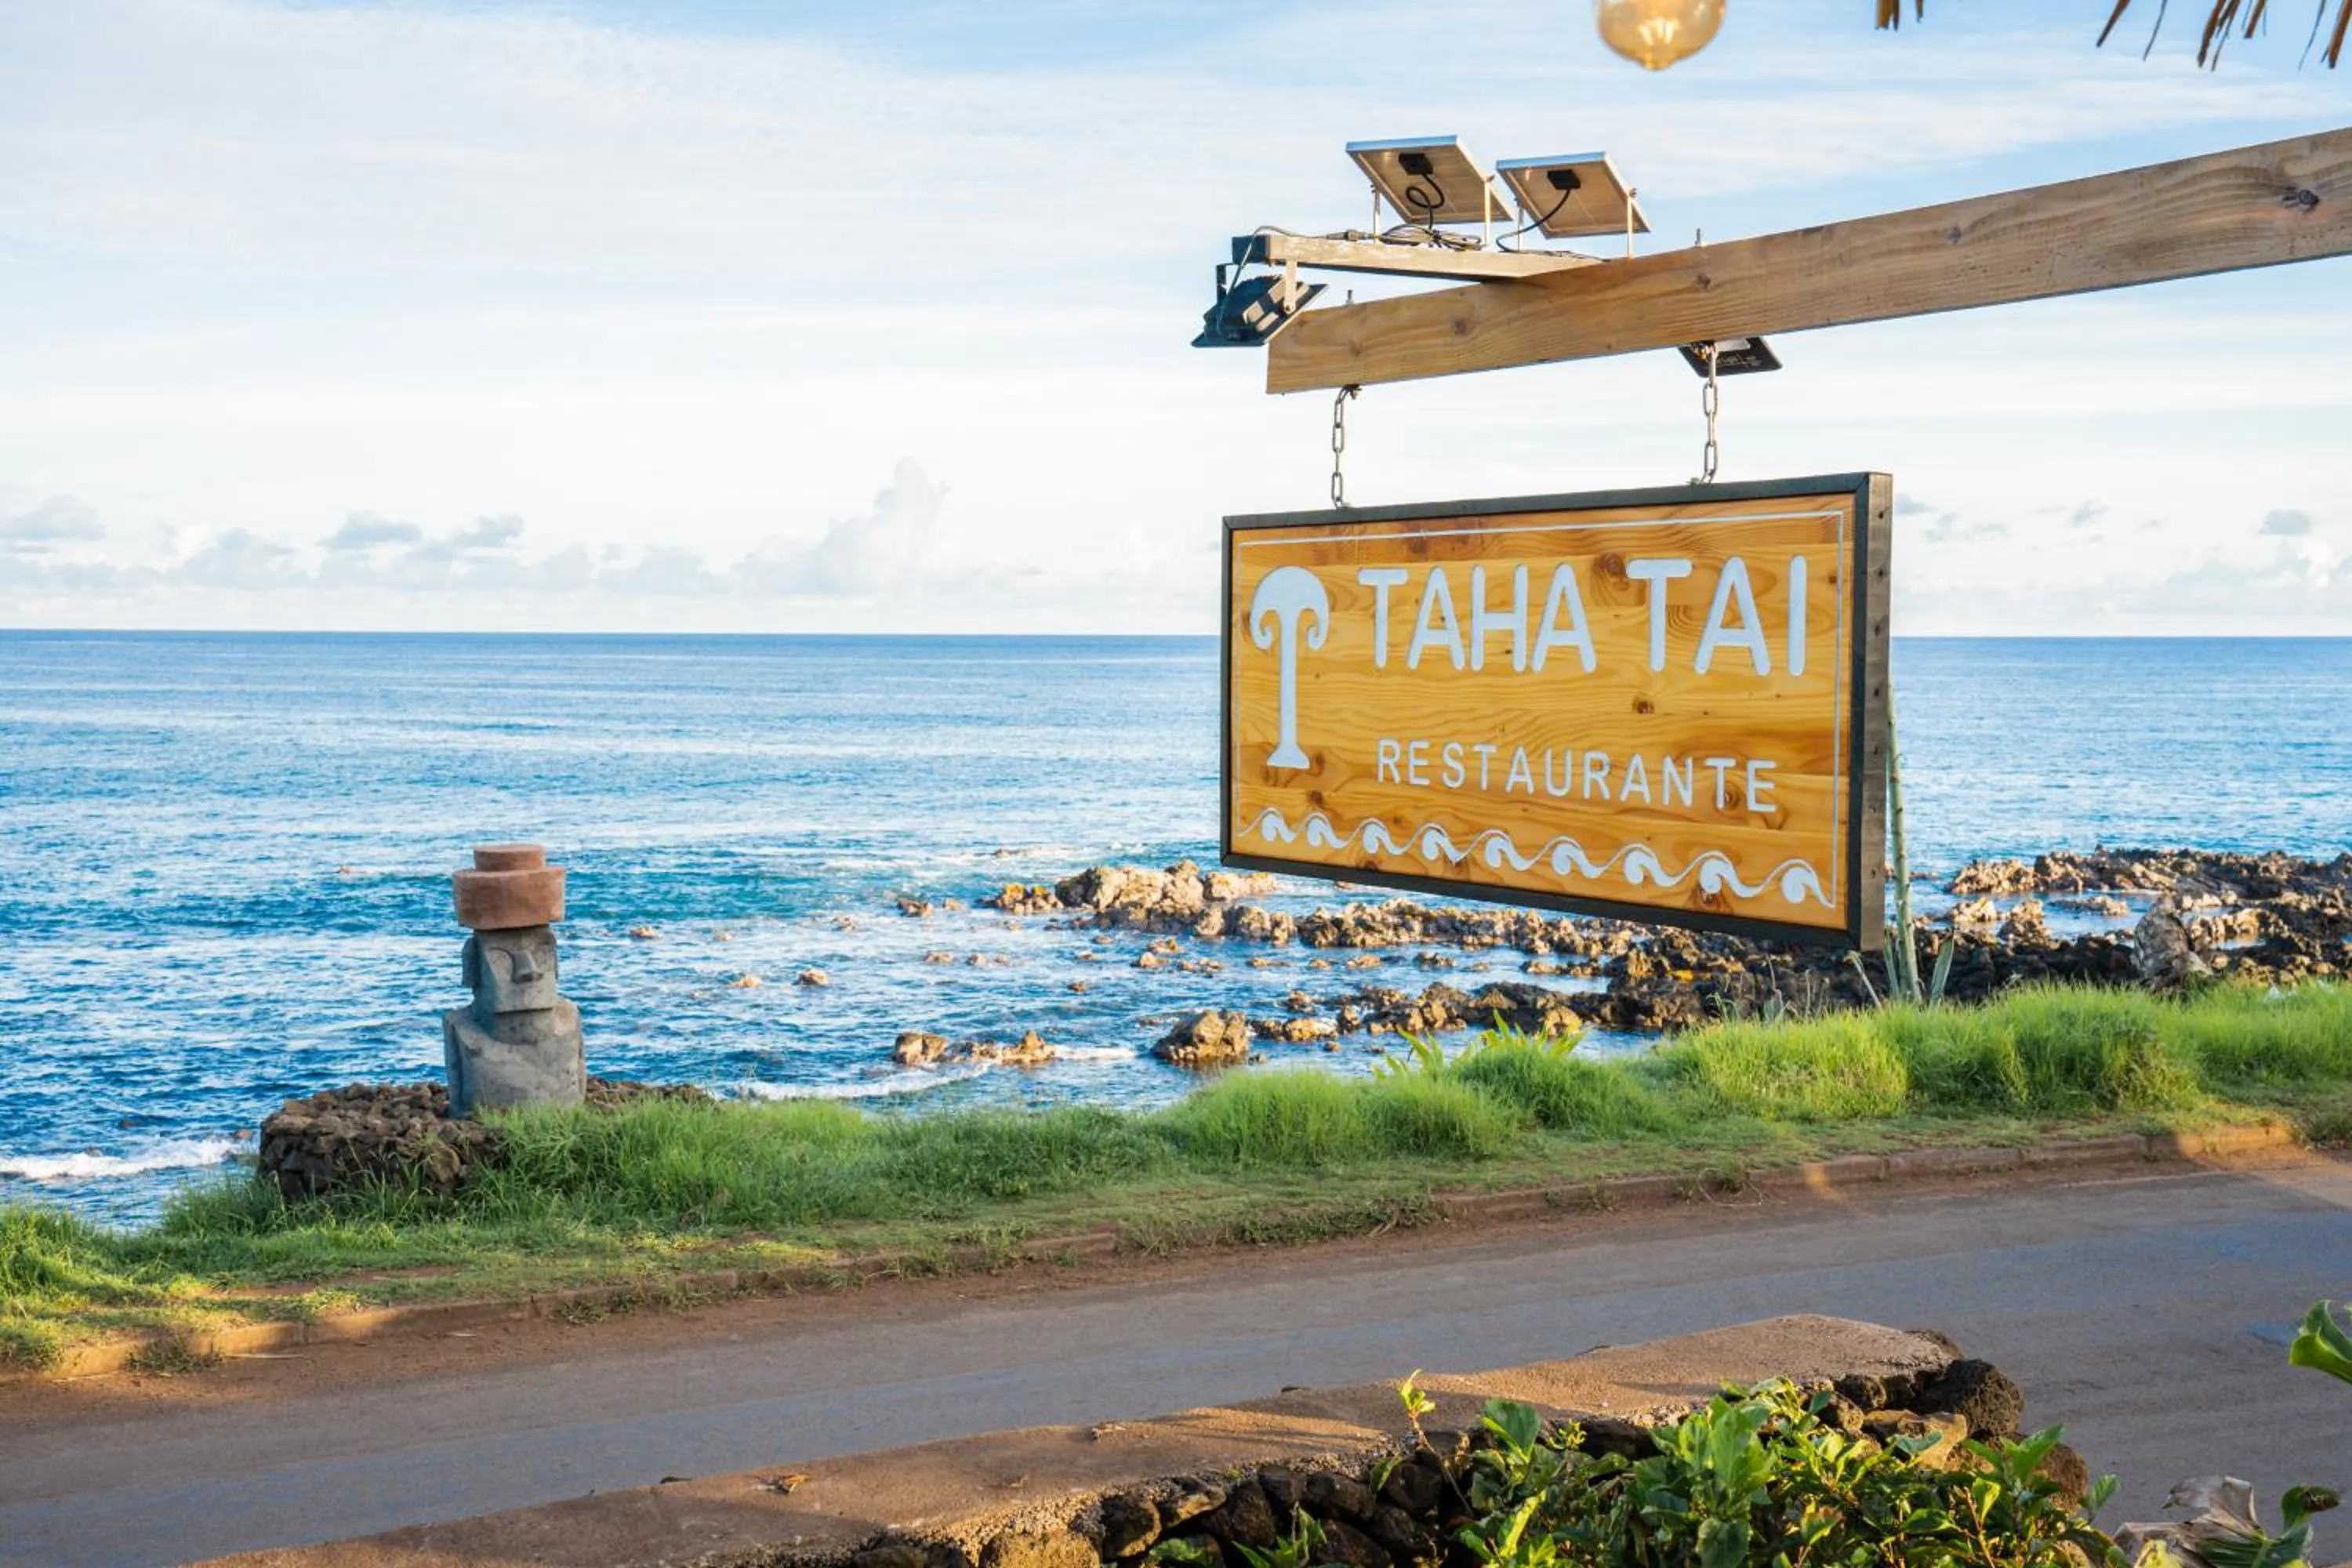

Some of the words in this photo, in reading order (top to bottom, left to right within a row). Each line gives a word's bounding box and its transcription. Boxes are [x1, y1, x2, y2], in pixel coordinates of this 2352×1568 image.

[1359, 563, 1596, 673] TAHA
[1627, 555, 1806, 677] TAI
[1378, 739, 1777, 812] RESTAURANTE
